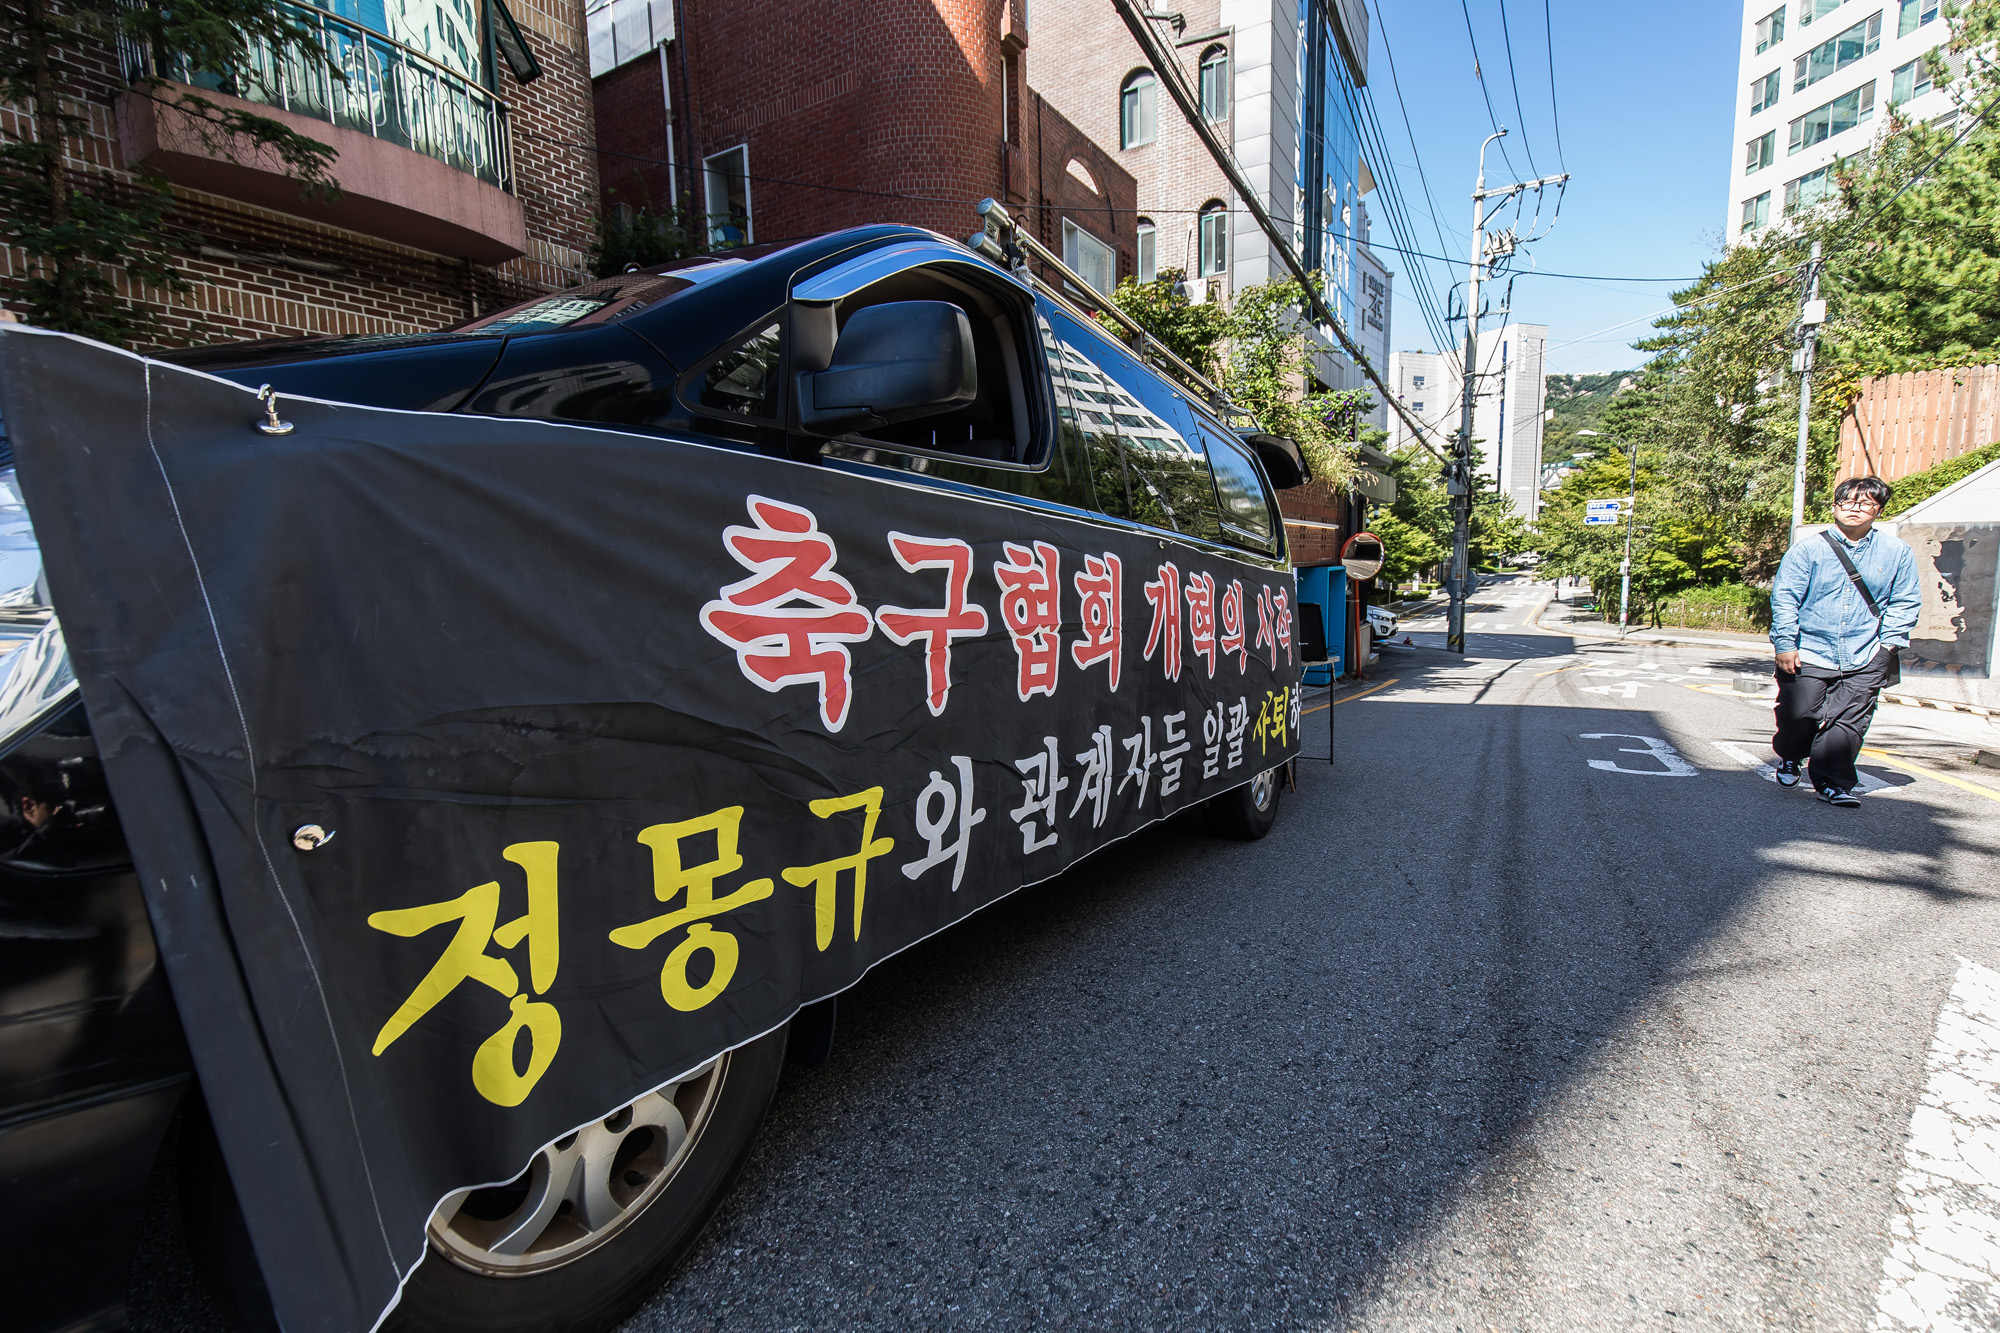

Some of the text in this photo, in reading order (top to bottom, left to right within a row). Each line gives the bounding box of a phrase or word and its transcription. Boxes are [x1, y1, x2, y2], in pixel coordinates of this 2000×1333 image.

[699, 494, 1293, 733] 축구협회 개혁의 시작
[366, 682, 1302, 1107] 정몽규와 관계자들 일괄 사퇴하
